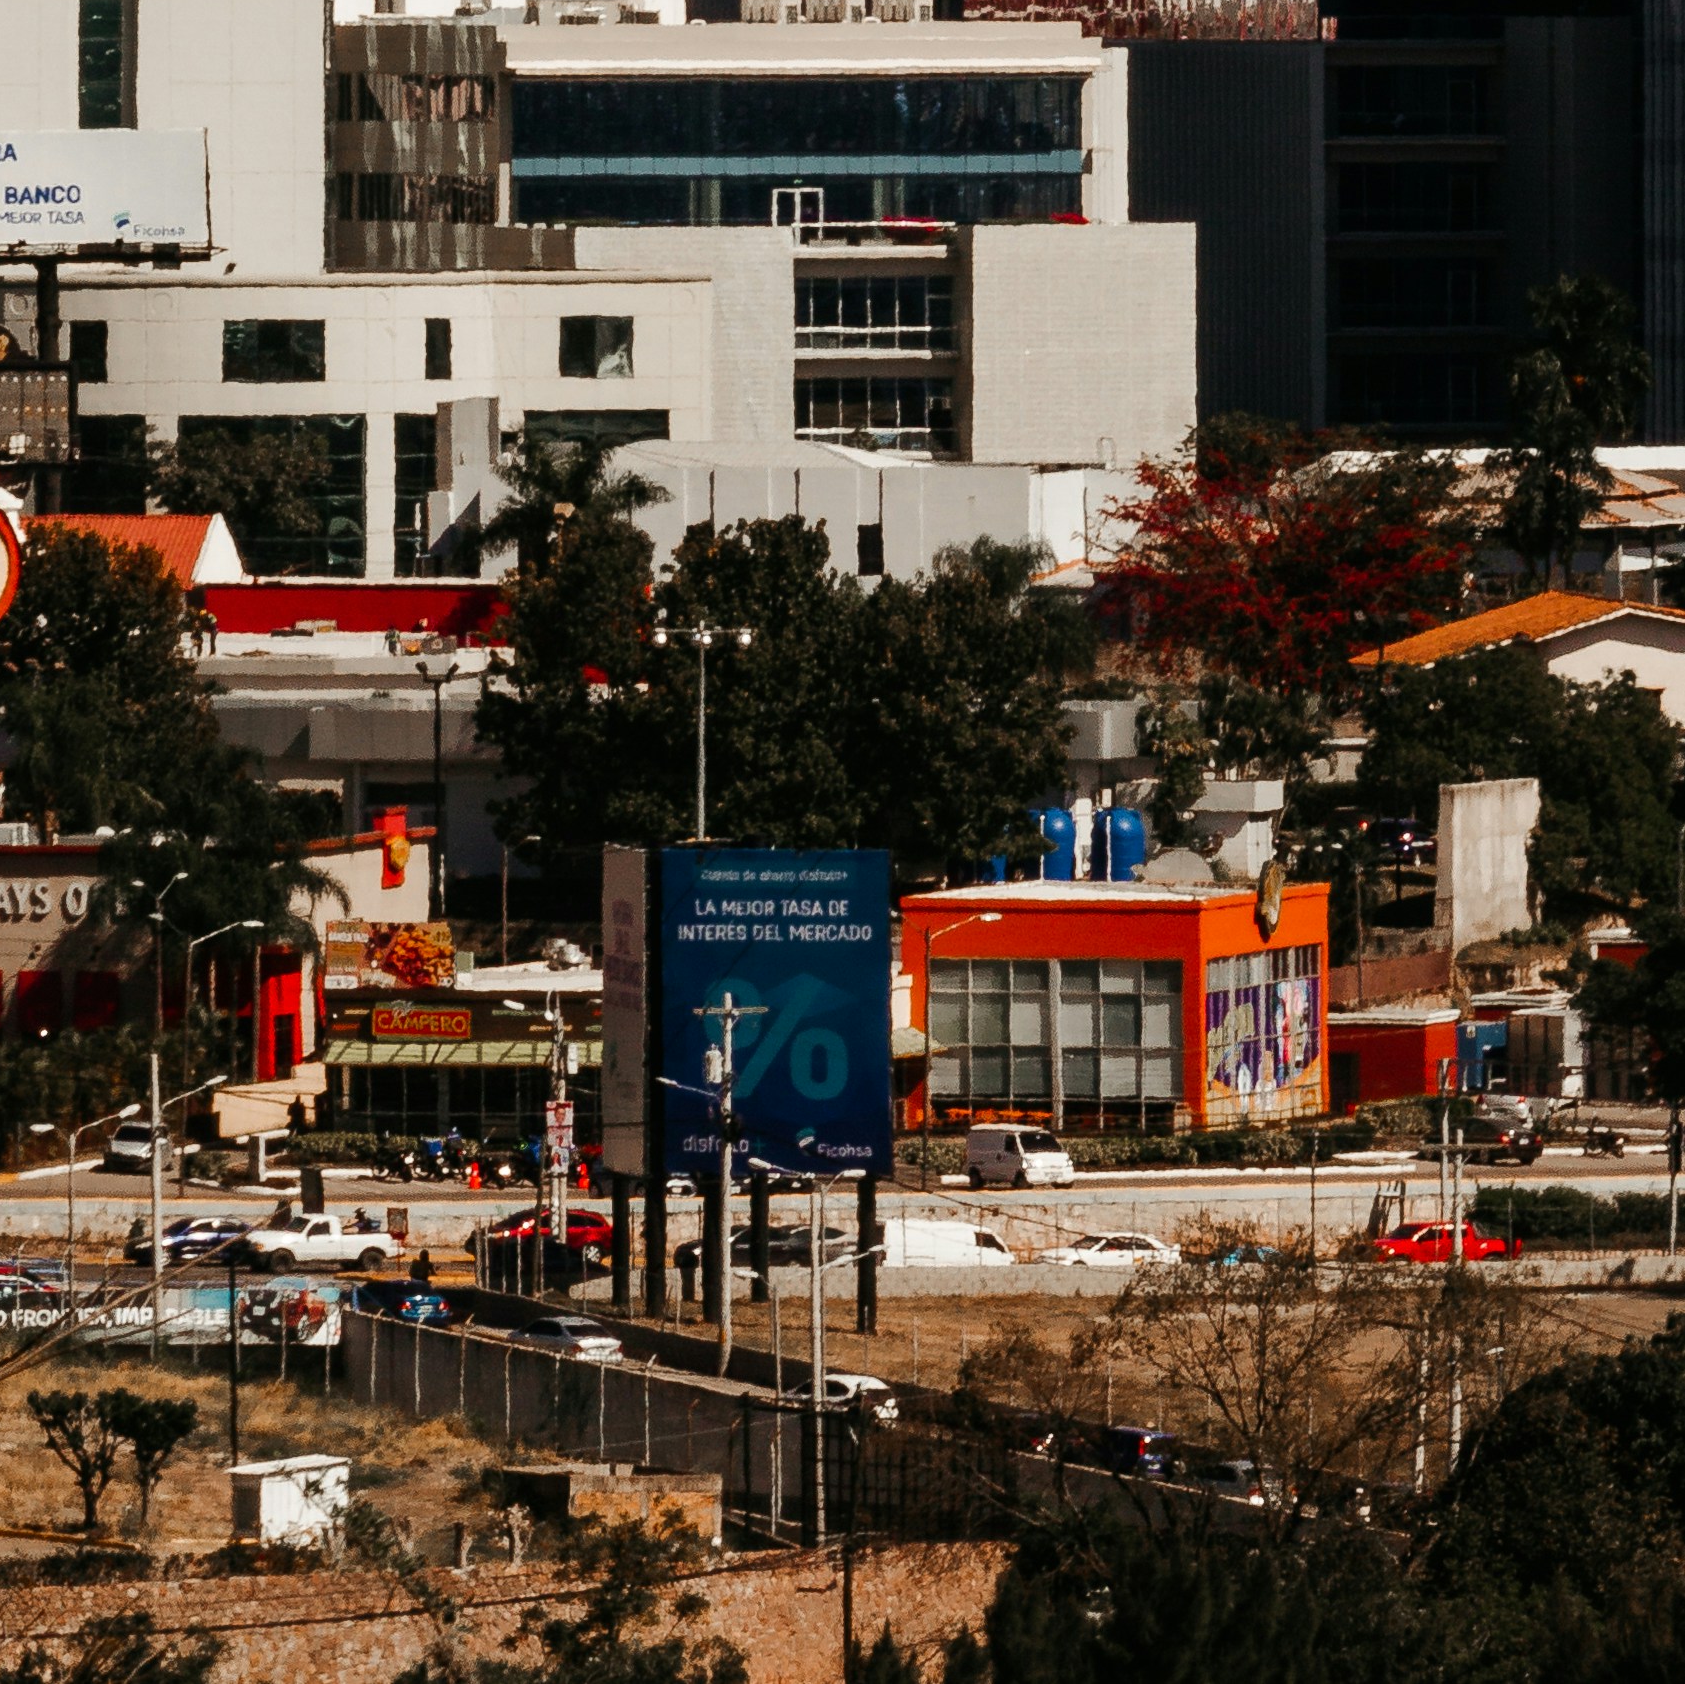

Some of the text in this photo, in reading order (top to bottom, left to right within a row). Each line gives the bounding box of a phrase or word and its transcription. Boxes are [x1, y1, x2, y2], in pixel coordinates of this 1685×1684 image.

[4, 185, 81, 205] BANCO
[47, 210, 85, 224] TASA
[695, 898, 849, 916] LA MEJOR TASA DE
[678, 919, 873, 941] INTERÉS DEL MERCADO
[377, 1013, 467, 1033] CAMPERO
[817, 1143, 873, 1158] Ficohsa
